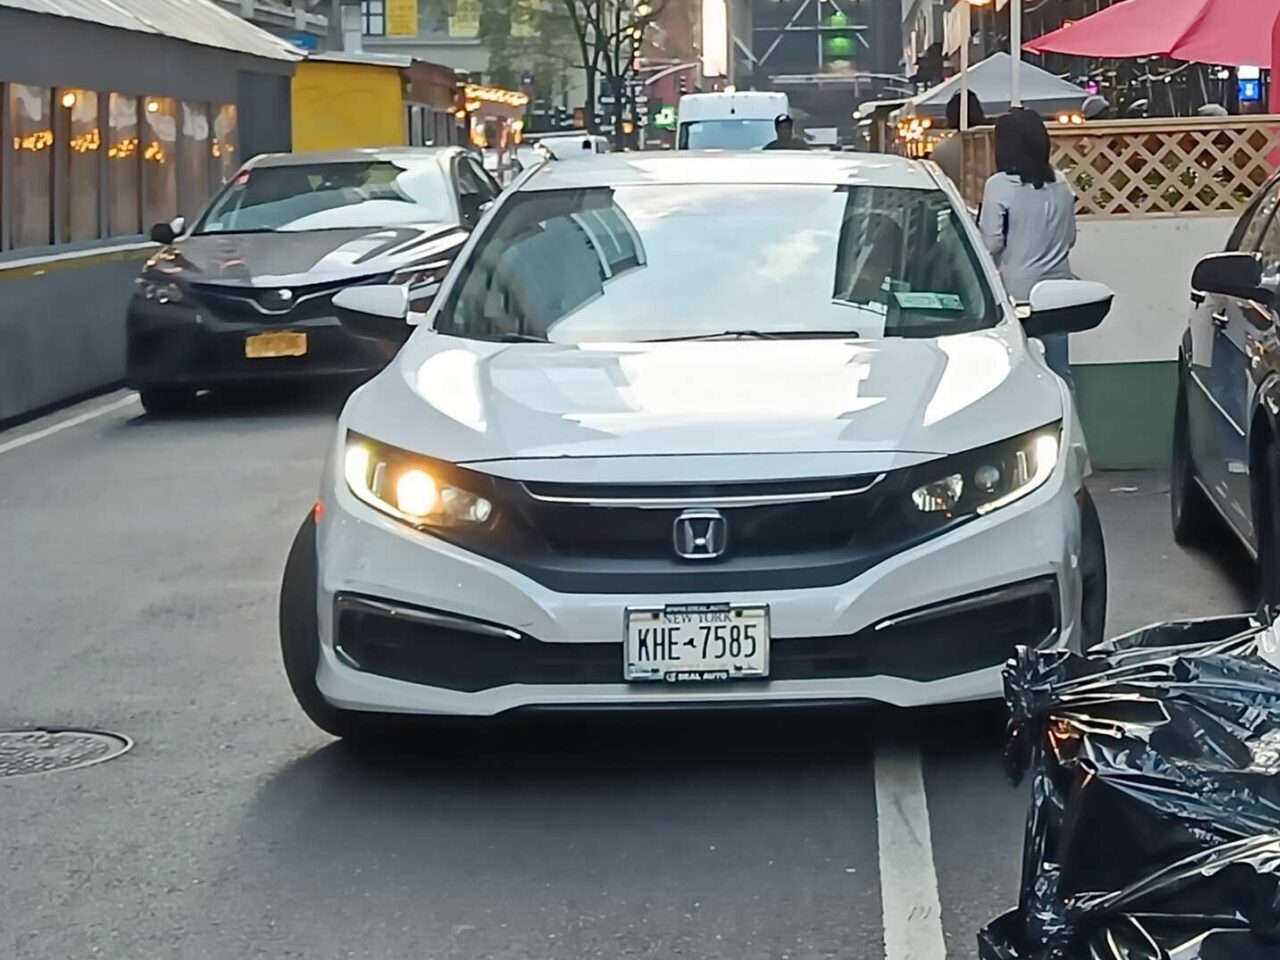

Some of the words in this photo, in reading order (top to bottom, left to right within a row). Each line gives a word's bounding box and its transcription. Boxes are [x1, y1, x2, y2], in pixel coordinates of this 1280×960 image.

[663, 613, 692, 624] NEW
[699, 612, 732, 624] YORK
[638, 627, 681, 661] KHE
[699, 624, 757, 659] 7585
